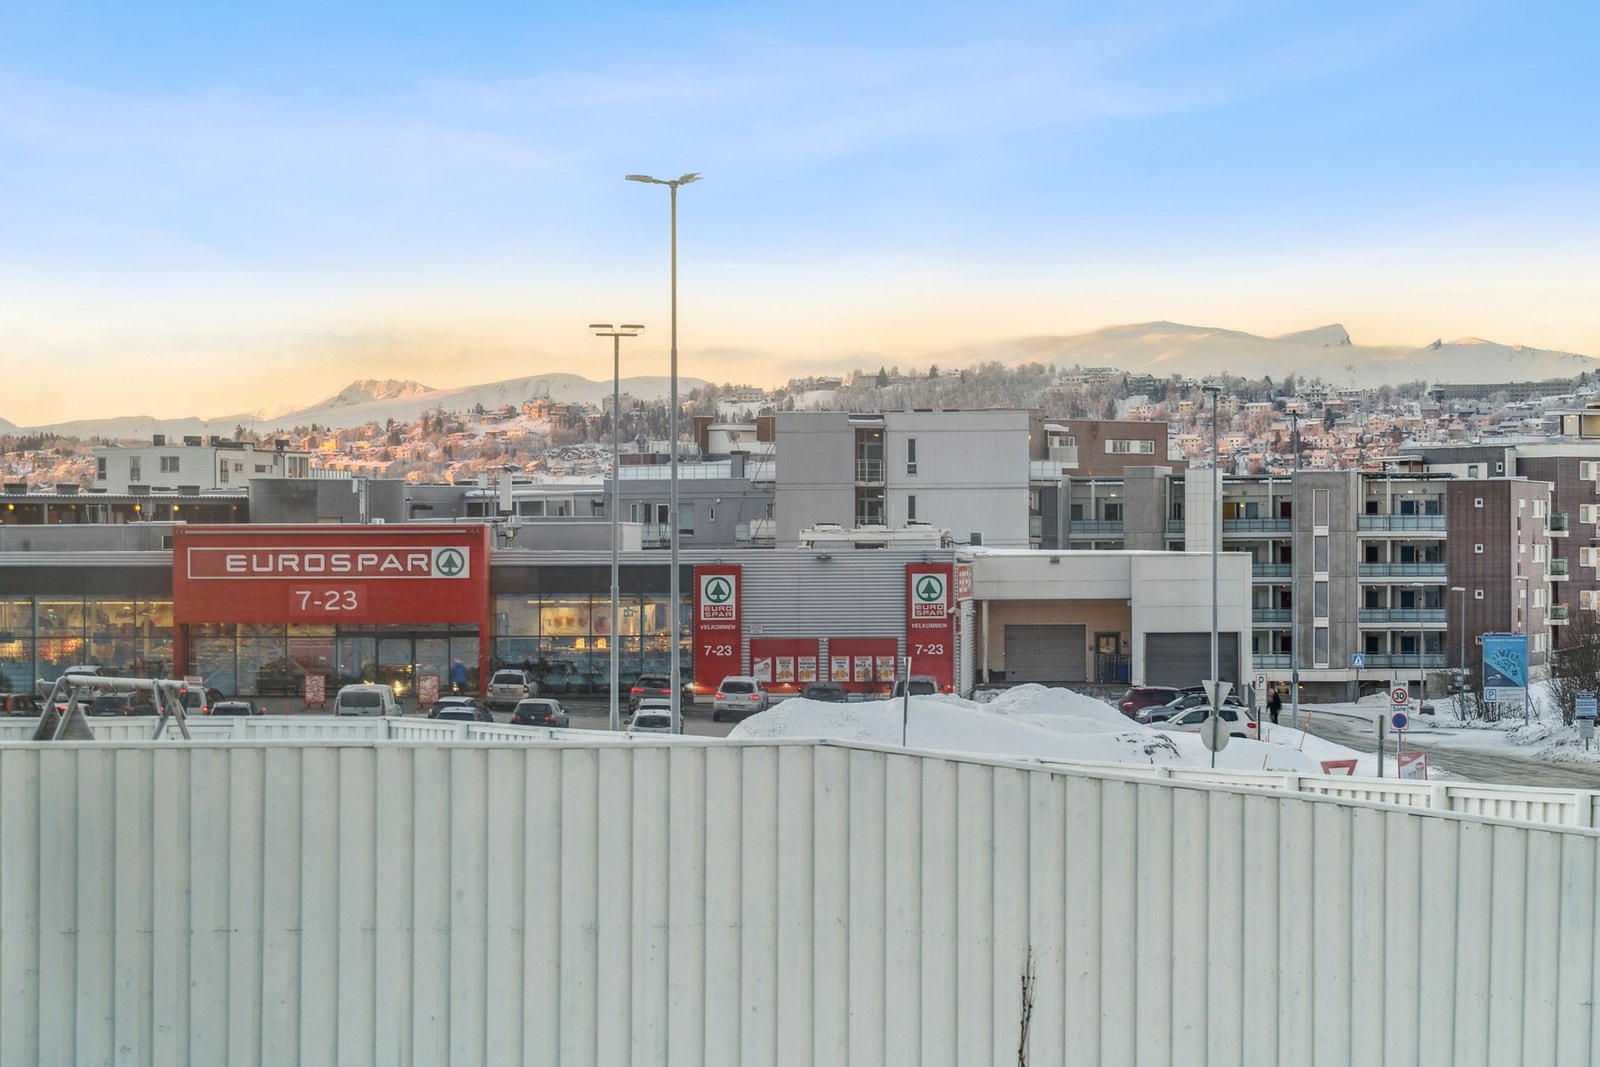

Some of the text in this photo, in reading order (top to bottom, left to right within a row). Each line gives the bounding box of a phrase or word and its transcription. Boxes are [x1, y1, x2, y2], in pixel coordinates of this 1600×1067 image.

[225, 553, 429, 573] EUROSPAR
[295, 590, 358, 611] 7-23
[704, 645, 732, 656] 7-23
[915, 644, 944, 655] 7-23
[1258, 676, 1264, 688] P
[1395, 692, 1405, 700] 30
[1488, 690, 1494, 698] P
